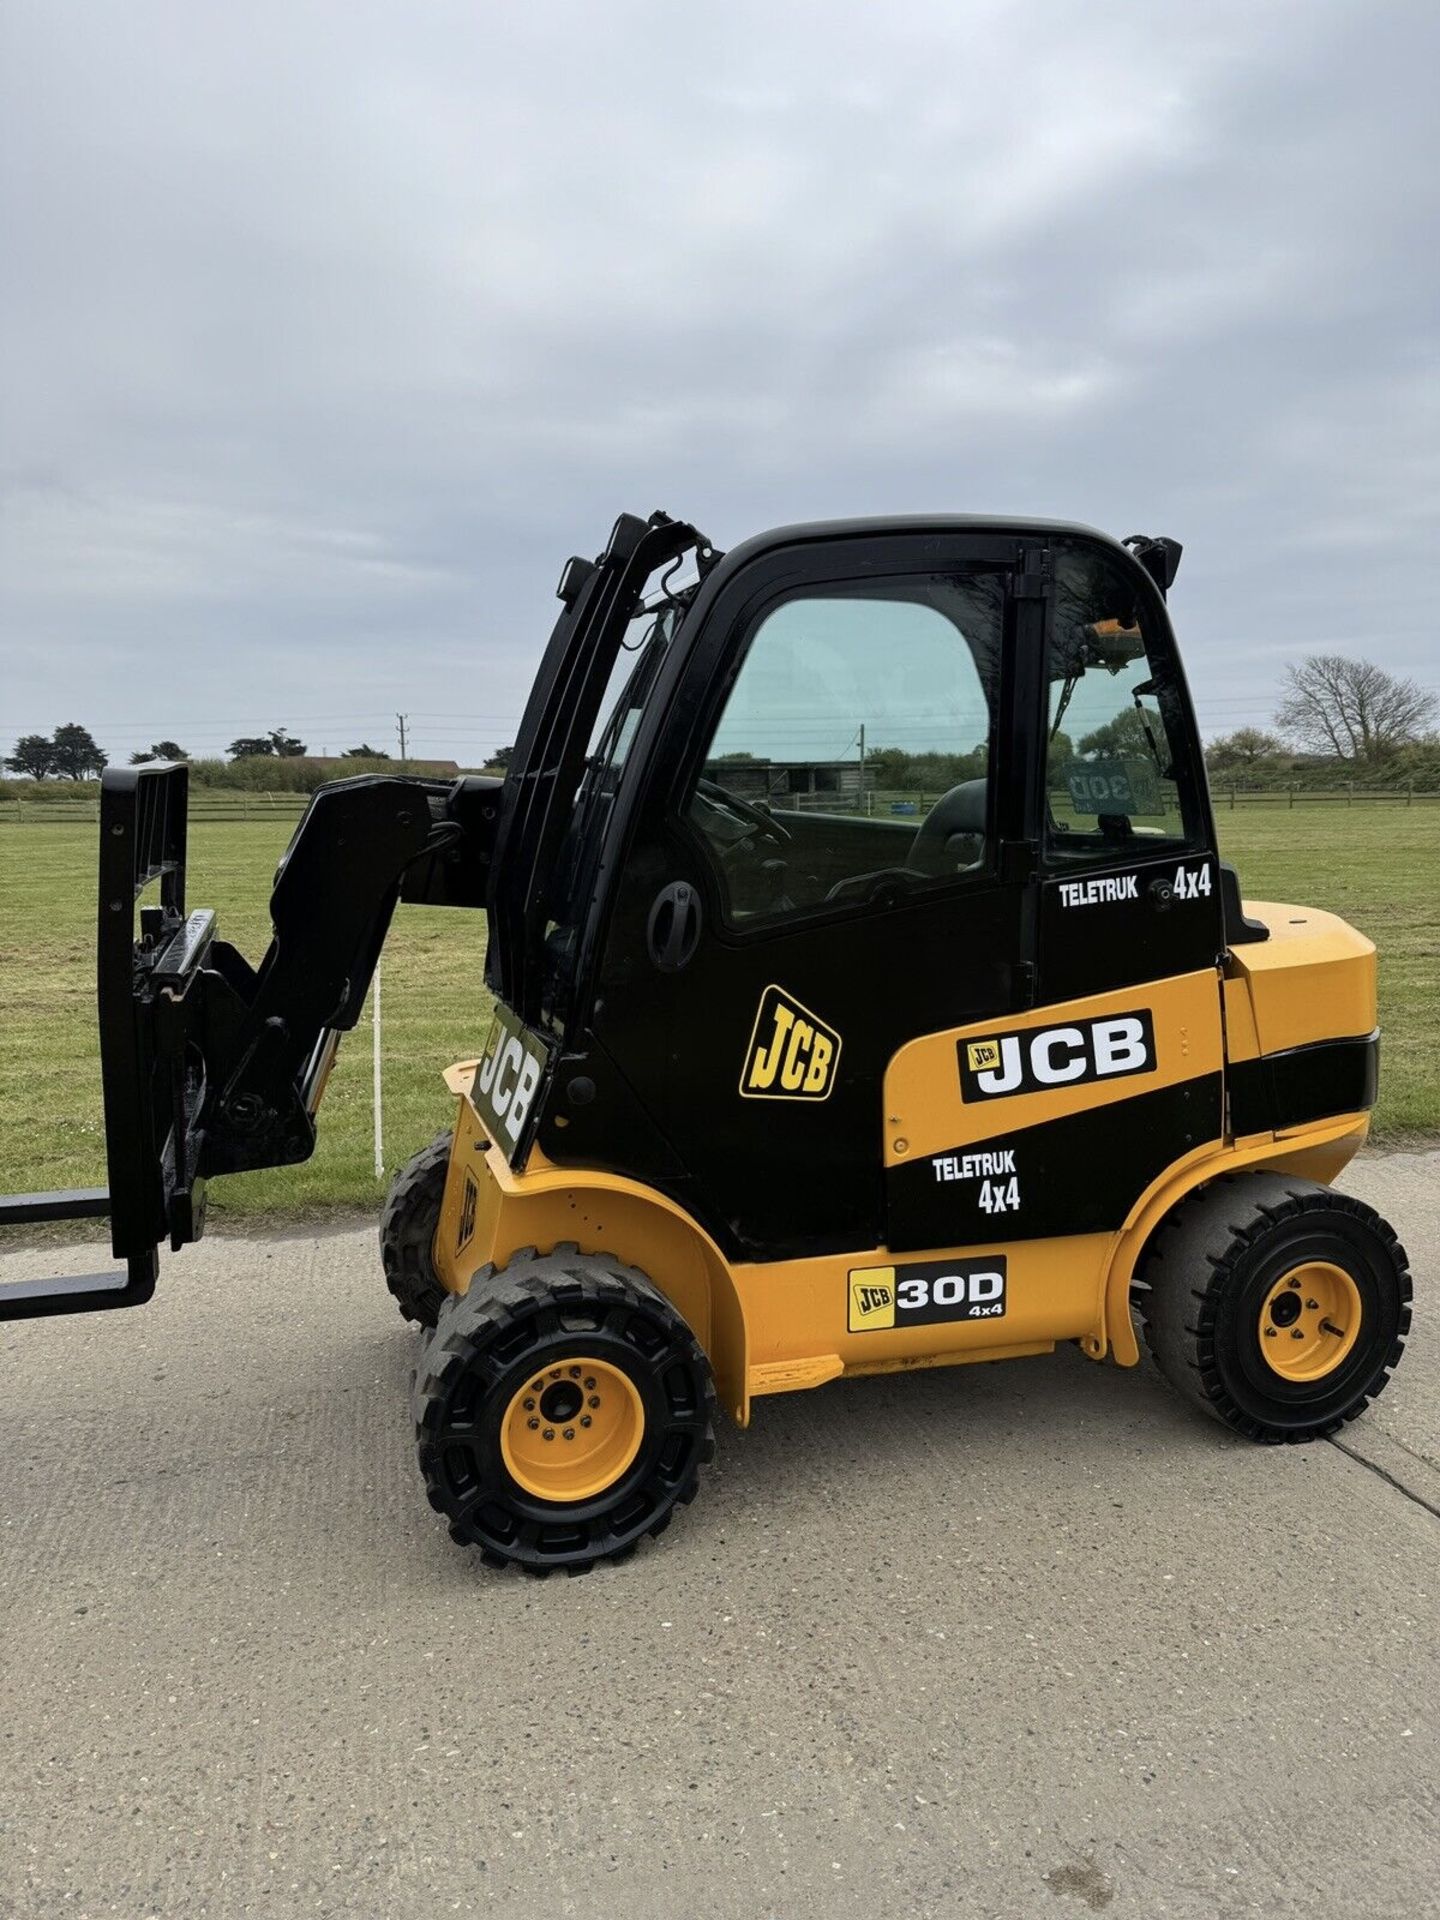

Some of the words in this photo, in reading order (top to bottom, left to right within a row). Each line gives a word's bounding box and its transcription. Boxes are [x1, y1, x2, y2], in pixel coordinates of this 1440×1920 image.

[1059, 875, 1139, 907] TELETRUK
[1173, 863, 1212, 900] 4x4
[749, 1003, 833, 1092] JCB
[975, 1046, 996, 1065] JCB
[977, 1017, 1147, 1094] JCB
[479, 1025, 541, 1143] JCB
[932, 1149, 1017, 1182] TELETRUK
[978, 1176, 1021, 1214] 4x4
[860, 1287, 890, 1313] JCB
[897, 1272, 1004, 1309] 30D
[968, 1303, 1003, 1317] 4x4
